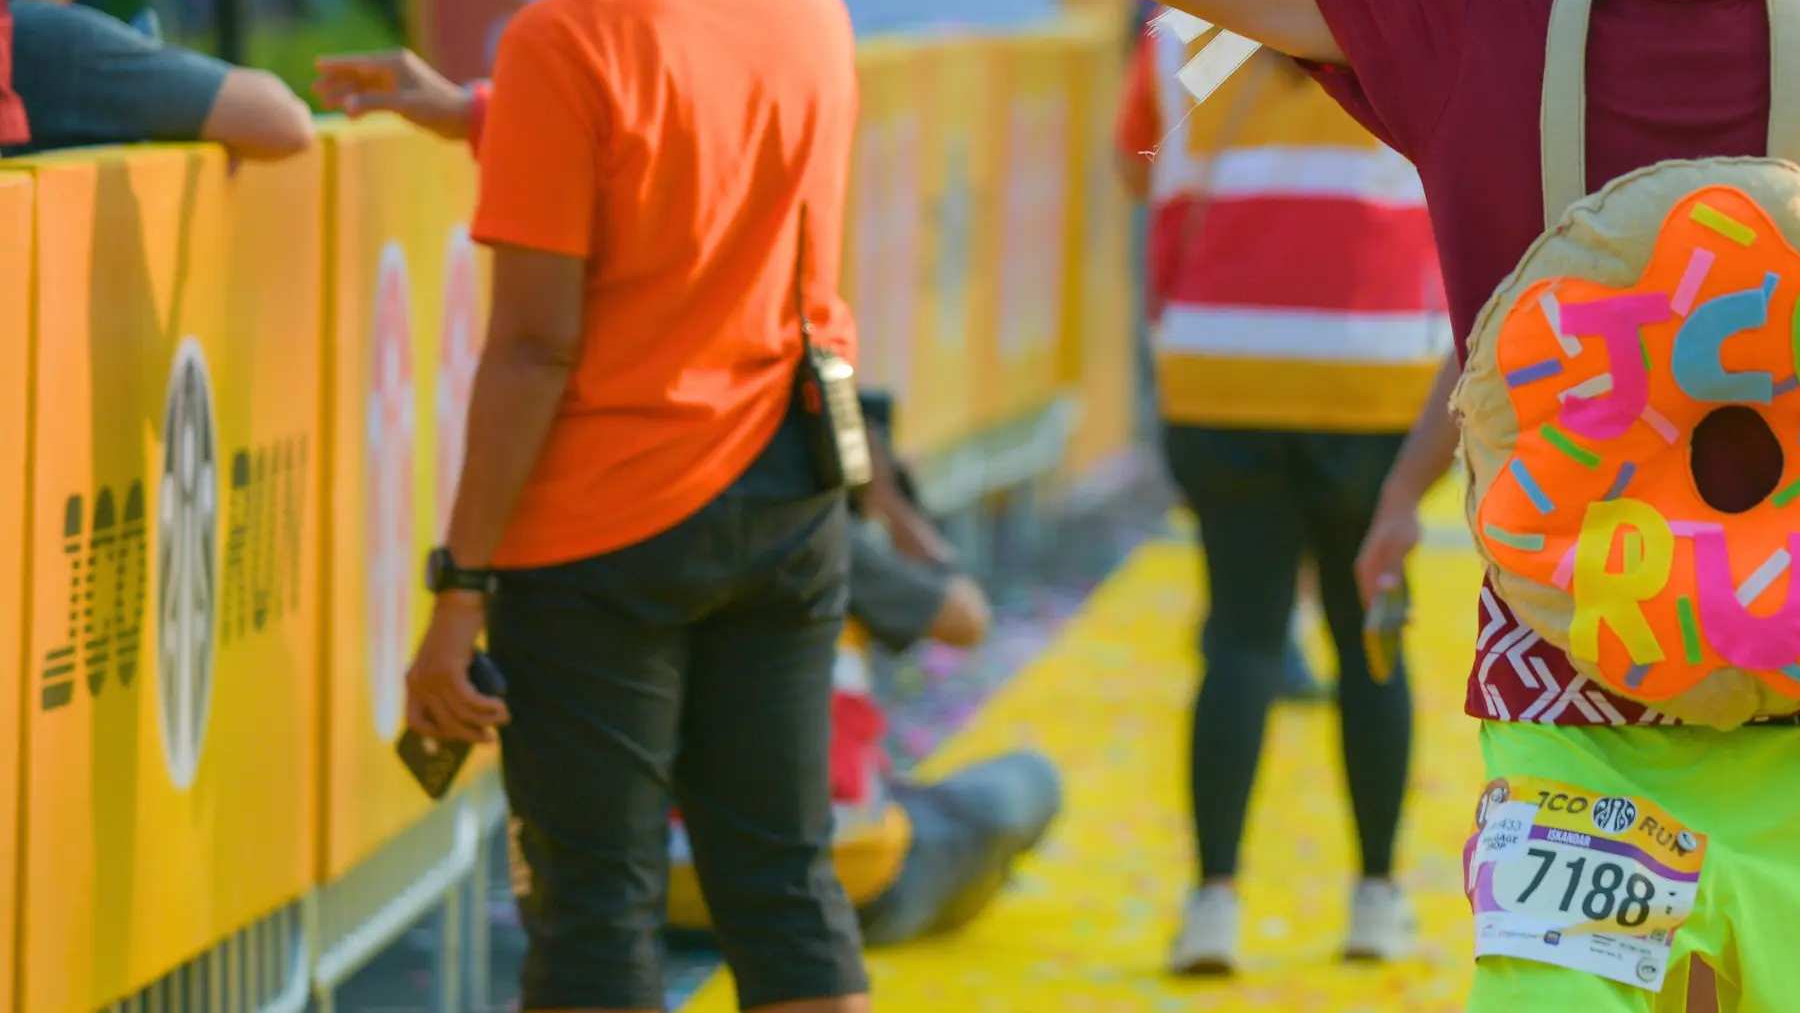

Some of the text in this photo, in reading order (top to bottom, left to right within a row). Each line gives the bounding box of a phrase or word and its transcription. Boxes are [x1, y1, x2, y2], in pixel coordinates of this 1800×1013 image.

[1538, 791, 1588, 814] JCO
[1546, 829, 1591, 847] ISKANDAR
[1516, 847, 1656, 927] 7188
